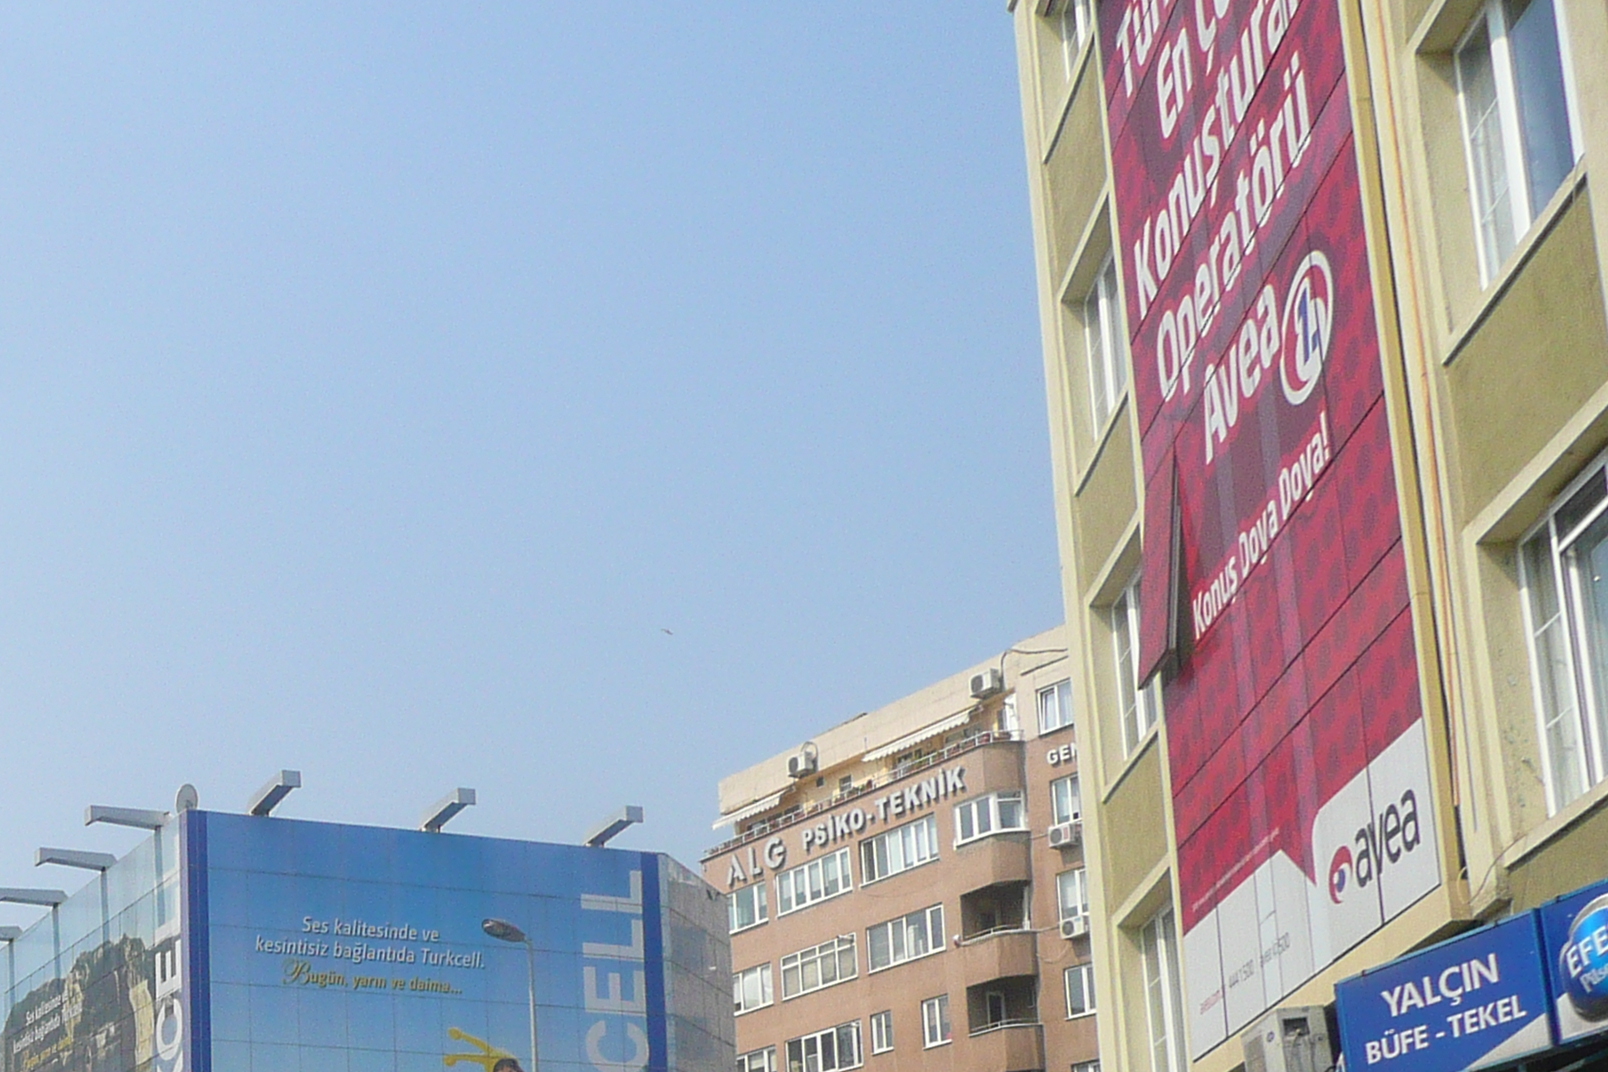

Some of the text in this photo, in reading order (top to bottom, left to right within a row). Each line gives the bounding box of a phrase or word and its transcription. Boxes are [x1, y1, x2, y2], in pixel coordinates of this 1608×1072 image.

[1157, 28, 1192, 139] En
[1157, 50, 1310, 403] Operatörü
[1204, 284, 1280, 465] Avea
[1193, 411, 1330, 640] Konuş Doya Doya!
[802, 765, 967, 853] PSİKO-TEKNİK
[1355, 789, 1420, 888] avea
[255, 935, 485, 968] kesintisiz bağlantıda Turkcell.
[302, 916, 439, 942] Ses kalitesinde ve
[392, 977, 405, 990] ve
[409, 976, 462, 994] daima...
[1380, 953, 1499, 1017] YALÇIN
[1365, 1025, 1429, 1065] BÜFE
[1447, 995, 1527, 1039] TEKEL
